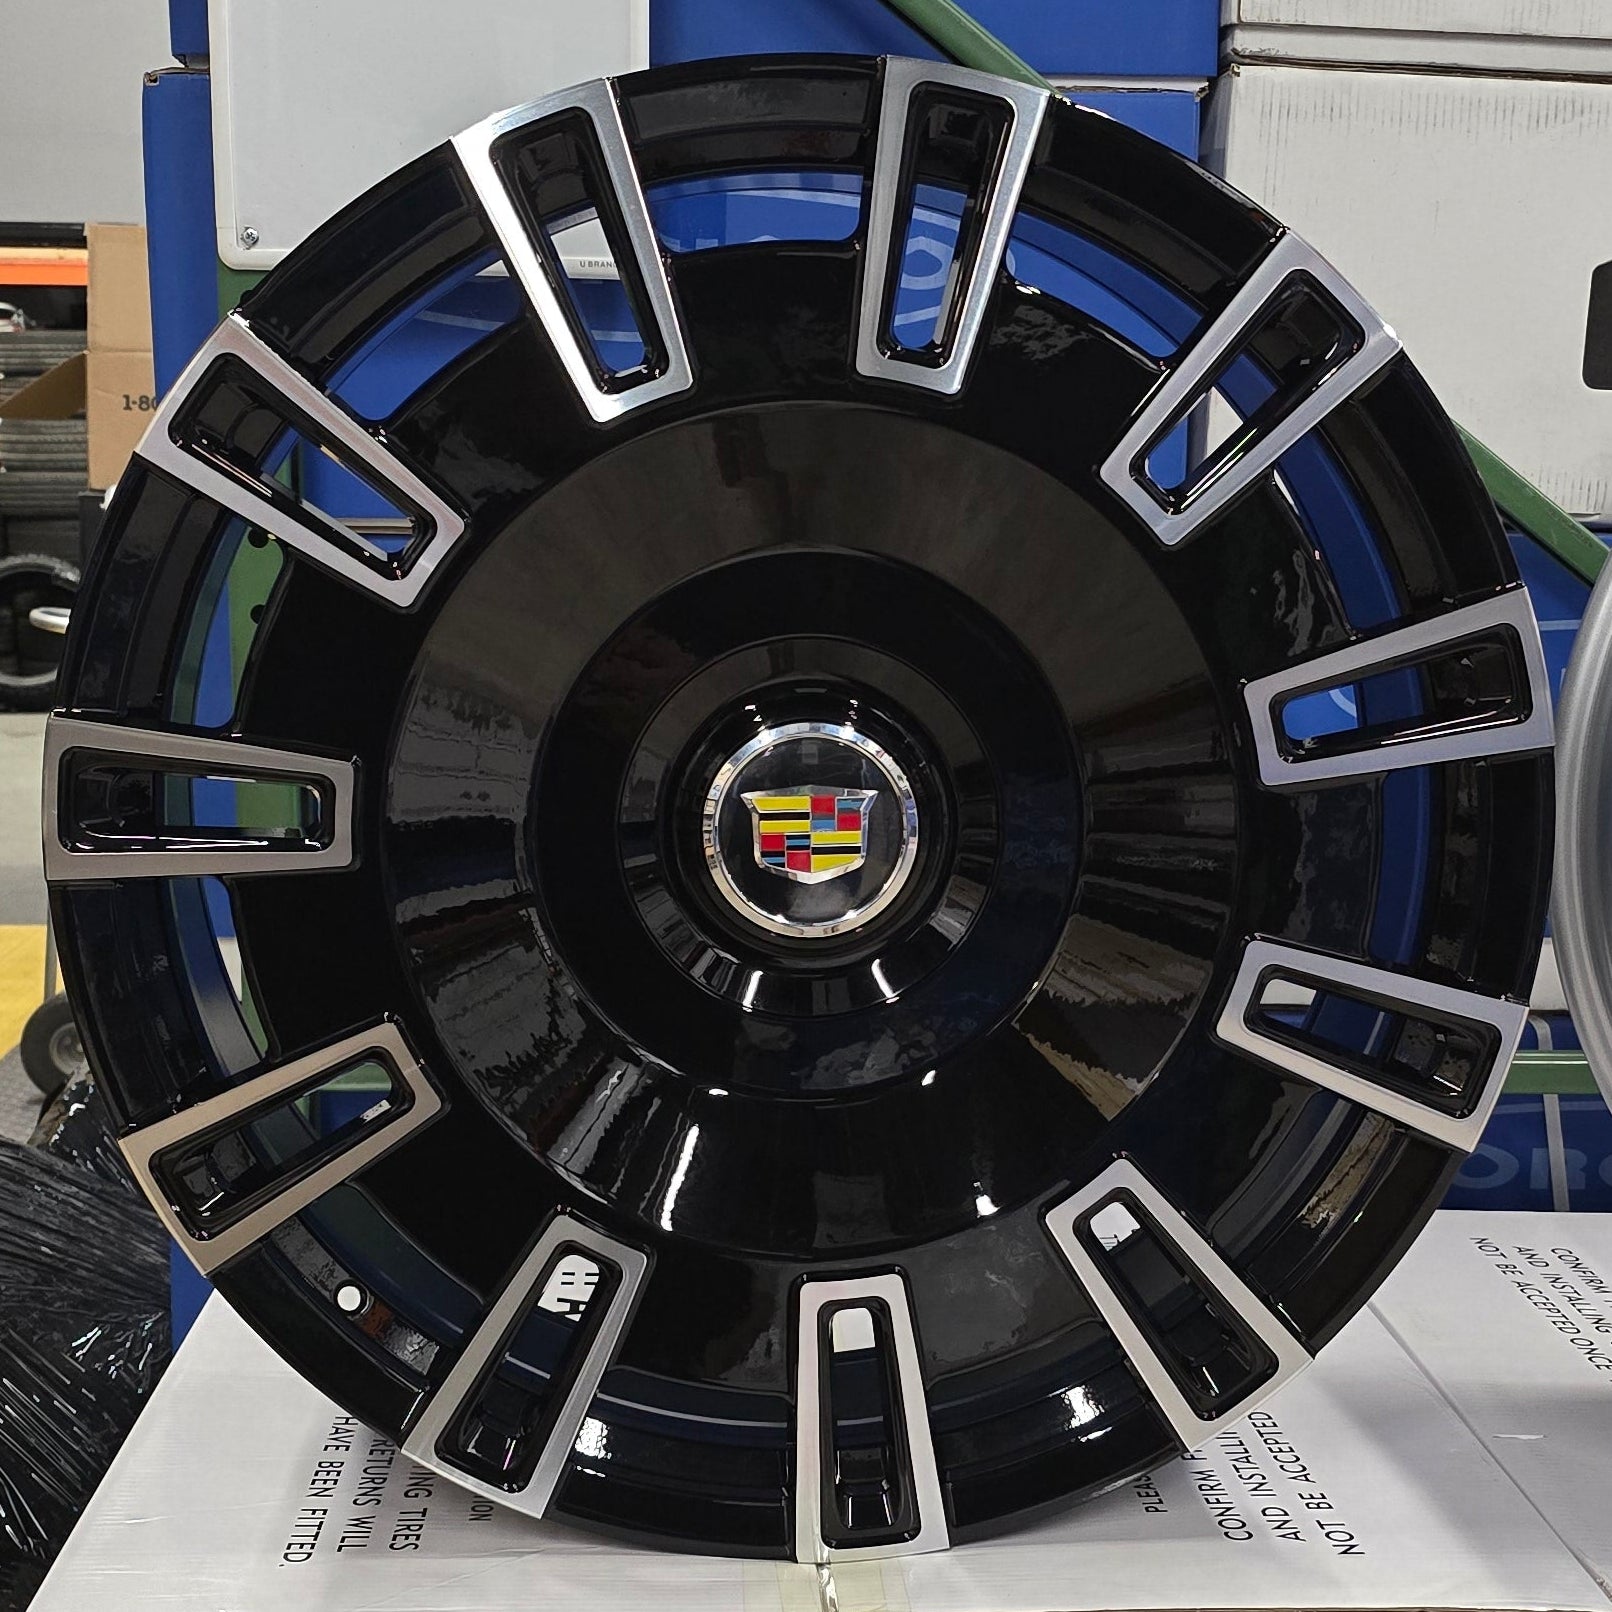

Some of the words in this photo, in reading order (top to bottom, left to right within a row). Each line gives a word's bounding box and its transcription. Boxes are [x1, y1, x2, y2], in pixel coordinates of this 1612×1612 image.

[1469, 1236, 1508, 1259] NOT
[1495, 1263, 1524, 1276] BE
[1511, 1280, 1581, 1334] ACCEPTED
[1512, 1245, 1549, 1268] AND
[1540, 1273, 1612, 1333] INSTALLING
[1551, 1248, 1612, 1293] CONFIRM
[323, 1416, 358, 1451] HAVE
[1247, 1411, 1317, 1484] ACCEPTED
[305, 1460, 345, 1498] BEEN
[352, 1438, 395, 1507] RETURNS
[1215, 1431, 1277, 1496] INSTALLI
[468, 1495, 495, 1521] ION
[1189, 1469, 1253, 1541] CONFIRM
[1298, 1491, 1335, 1510] BE
[336, 1515, 376, 1553] WILL
[388, 1507, 428, 1551] TIRES
[1260, 1506, 1307, 1542] AND
[1315, 1519, 1365, 1555] NOT
